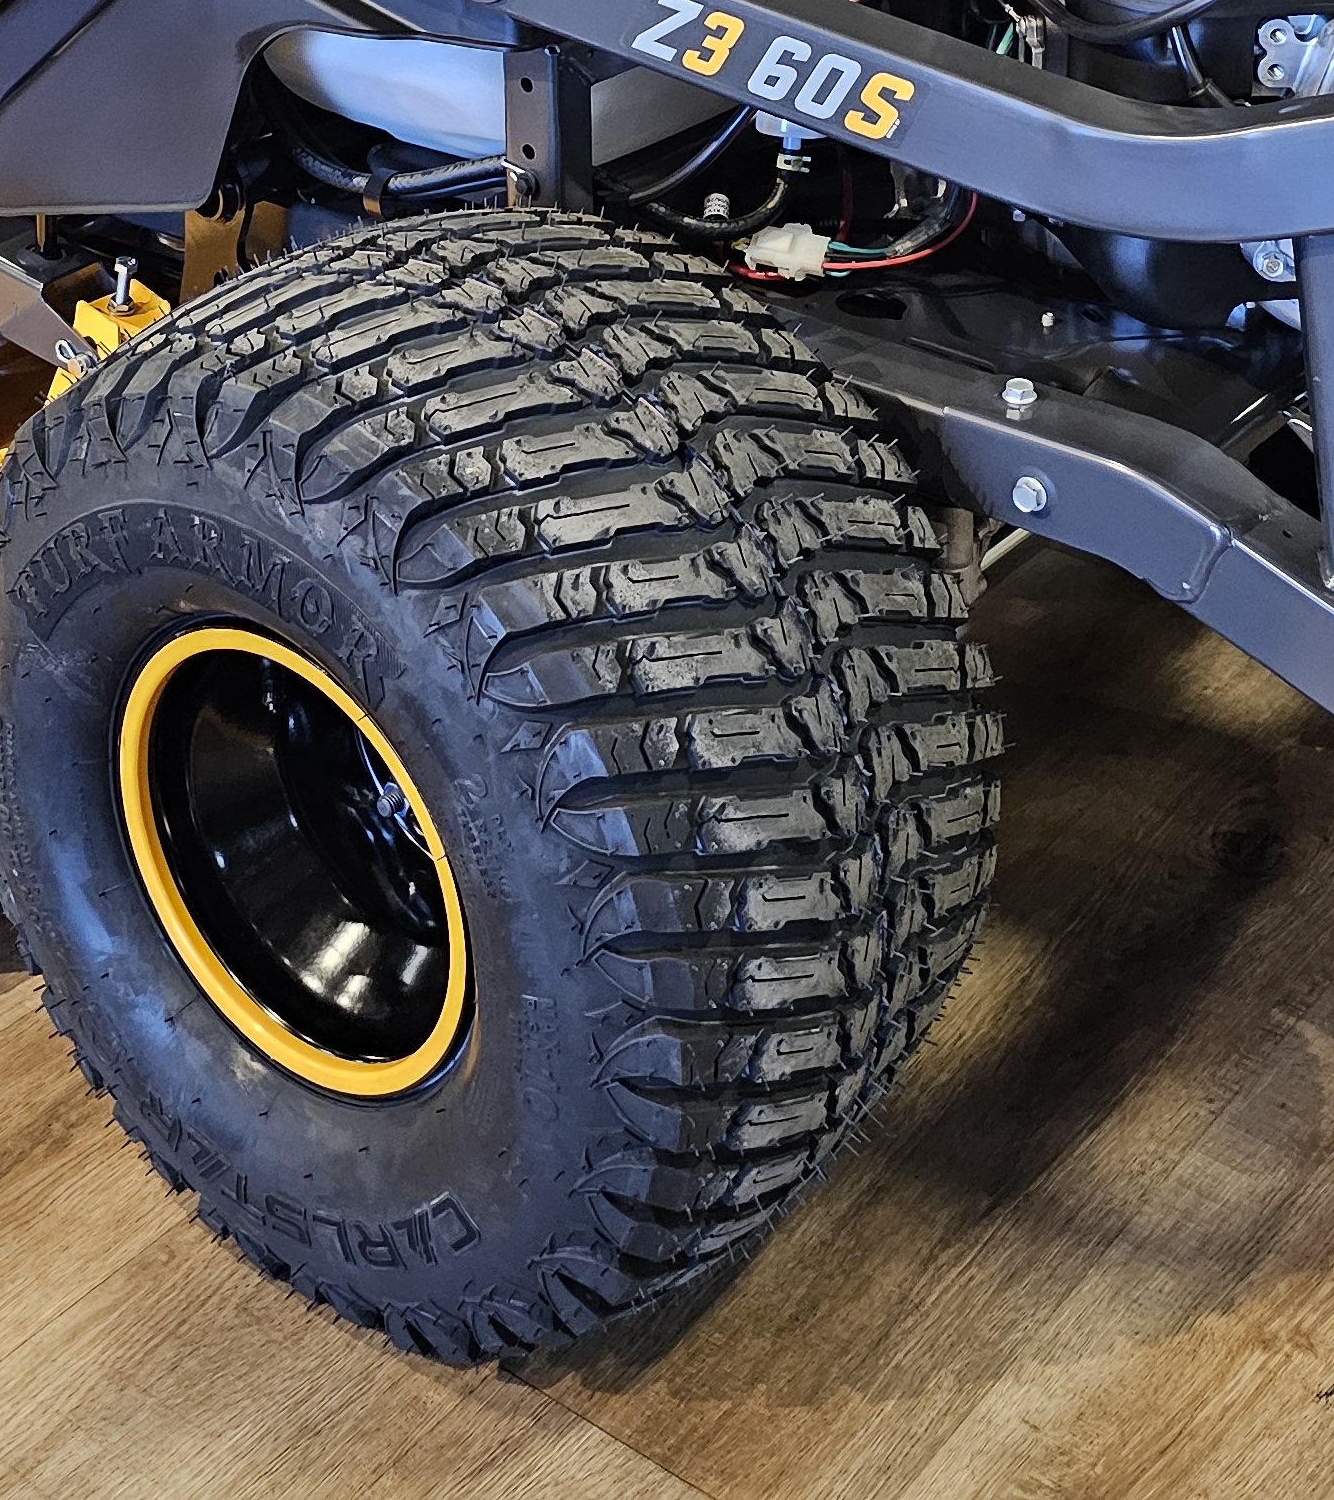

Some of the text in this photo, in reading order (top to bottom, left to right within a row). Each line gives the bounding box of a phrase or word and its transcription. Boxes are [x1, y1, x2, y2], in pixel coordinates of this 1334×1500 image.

[747, 35, 916, 141] 60S
[8, 507, 380, 685] TURF ARMOR
